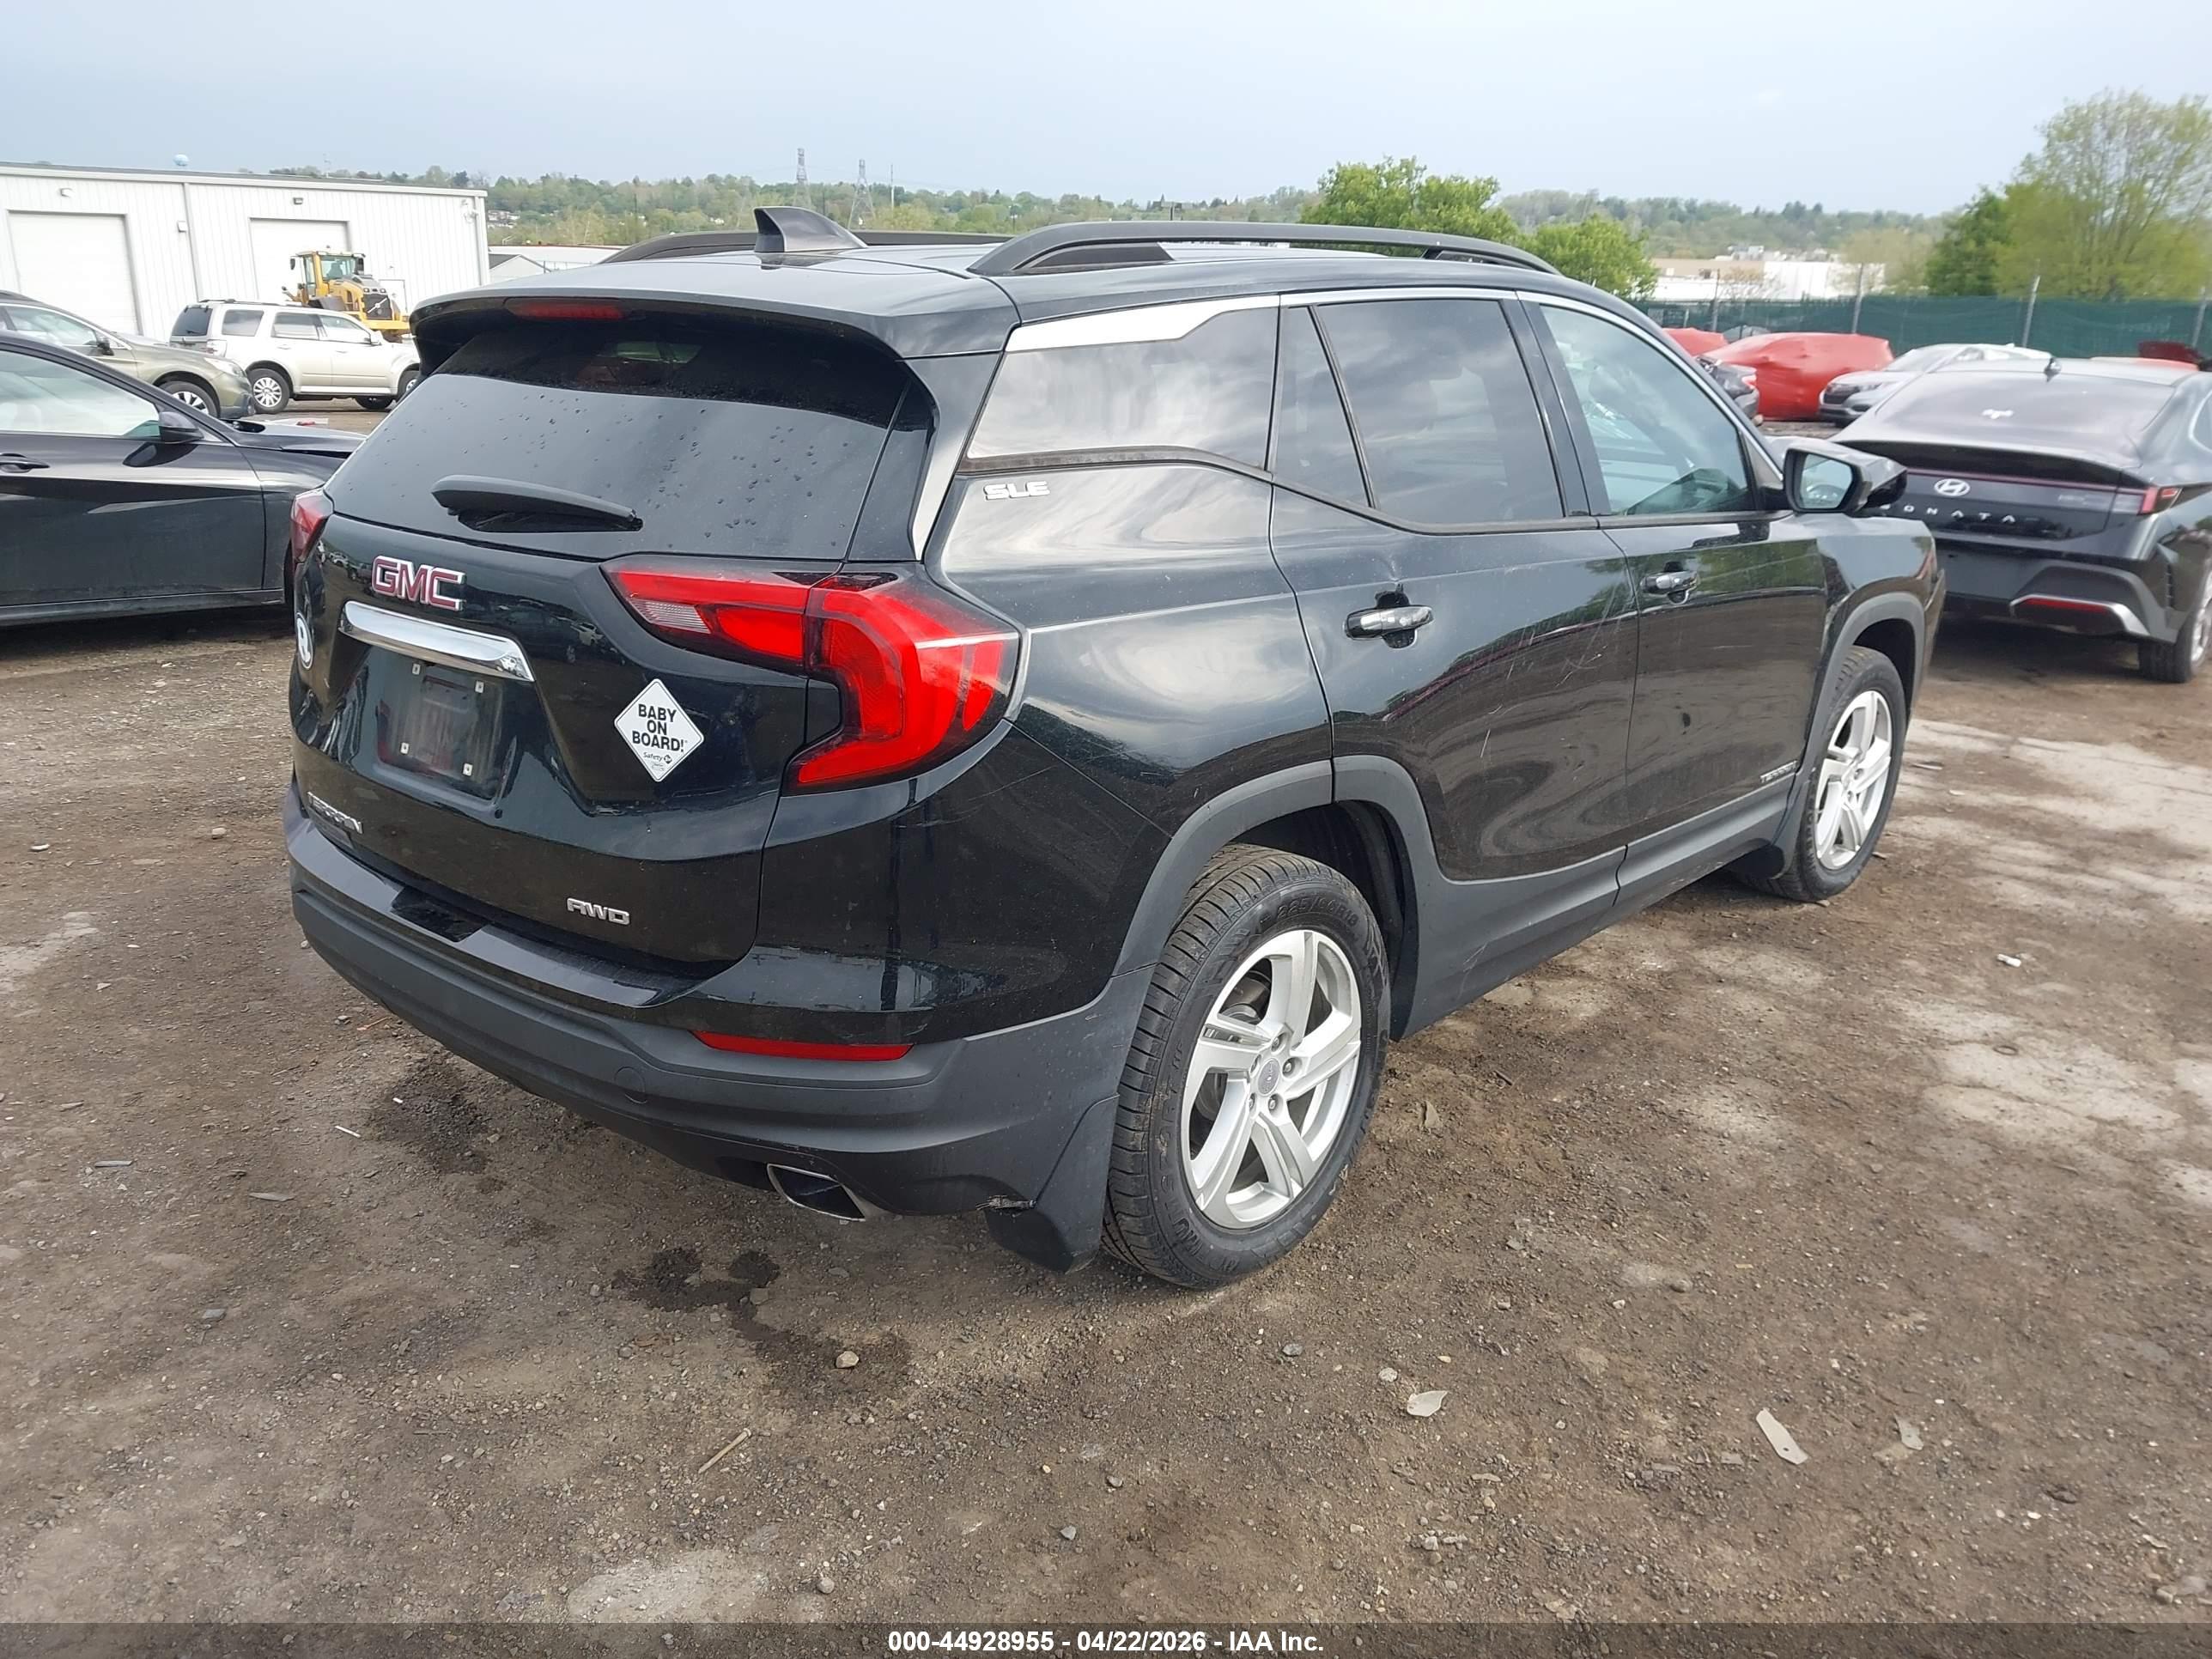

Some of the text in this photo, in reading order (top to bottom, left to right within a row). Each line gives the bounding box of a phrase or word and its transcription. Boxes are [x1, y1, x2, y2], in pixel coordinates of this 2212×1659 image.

[983, 480, 1051, 501] SLE
[371, 555, 467, 612] GMC
[638, 703, 678, 723] BABY
[647, 720, 667, 736] ON
[567, 897, 631, 926] AWD
